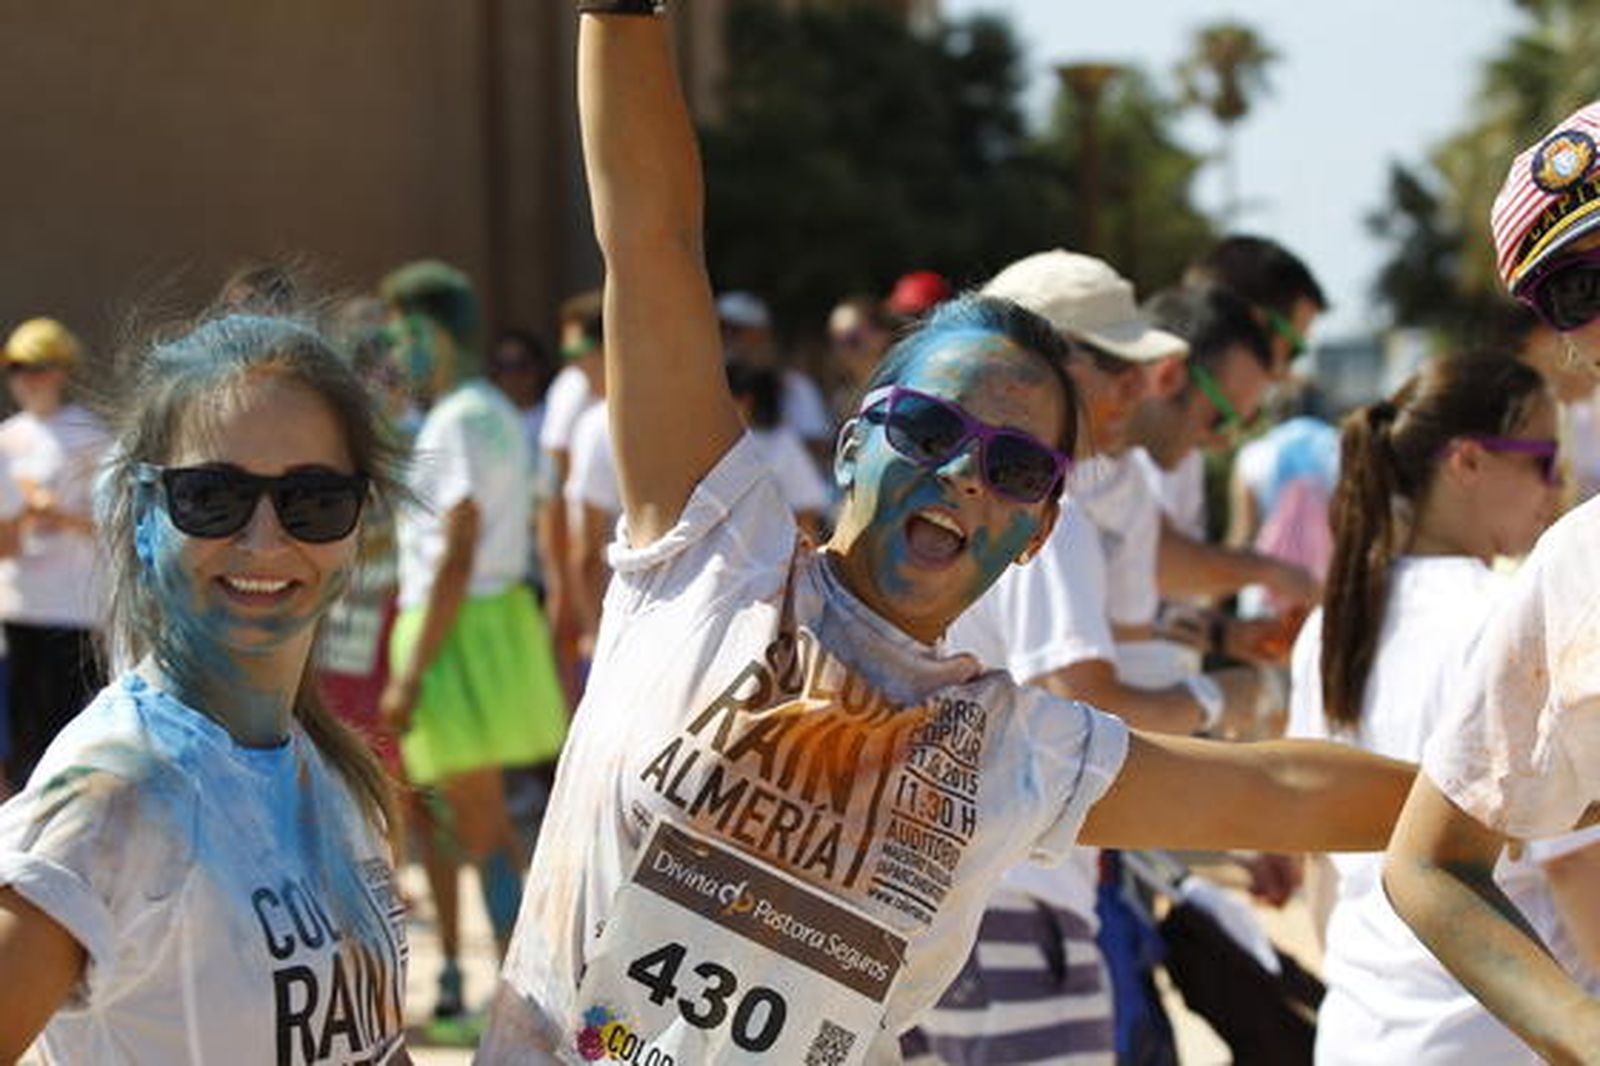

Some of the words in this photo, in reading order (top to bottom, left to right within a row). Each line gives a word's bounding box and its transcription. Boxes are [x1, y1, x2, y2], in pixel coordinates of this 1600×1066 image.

[688, 660, 866, 814] RAIN
[640, 737, 844, 879] ALMERÍA
[962, 805, 976, 839] H
[652, 850, 716, 896] Divina
[752, 899, 826, 950] Pastora
[824, 934, 890, 981] Seguros
[627, 942, 787, 1052] 430
